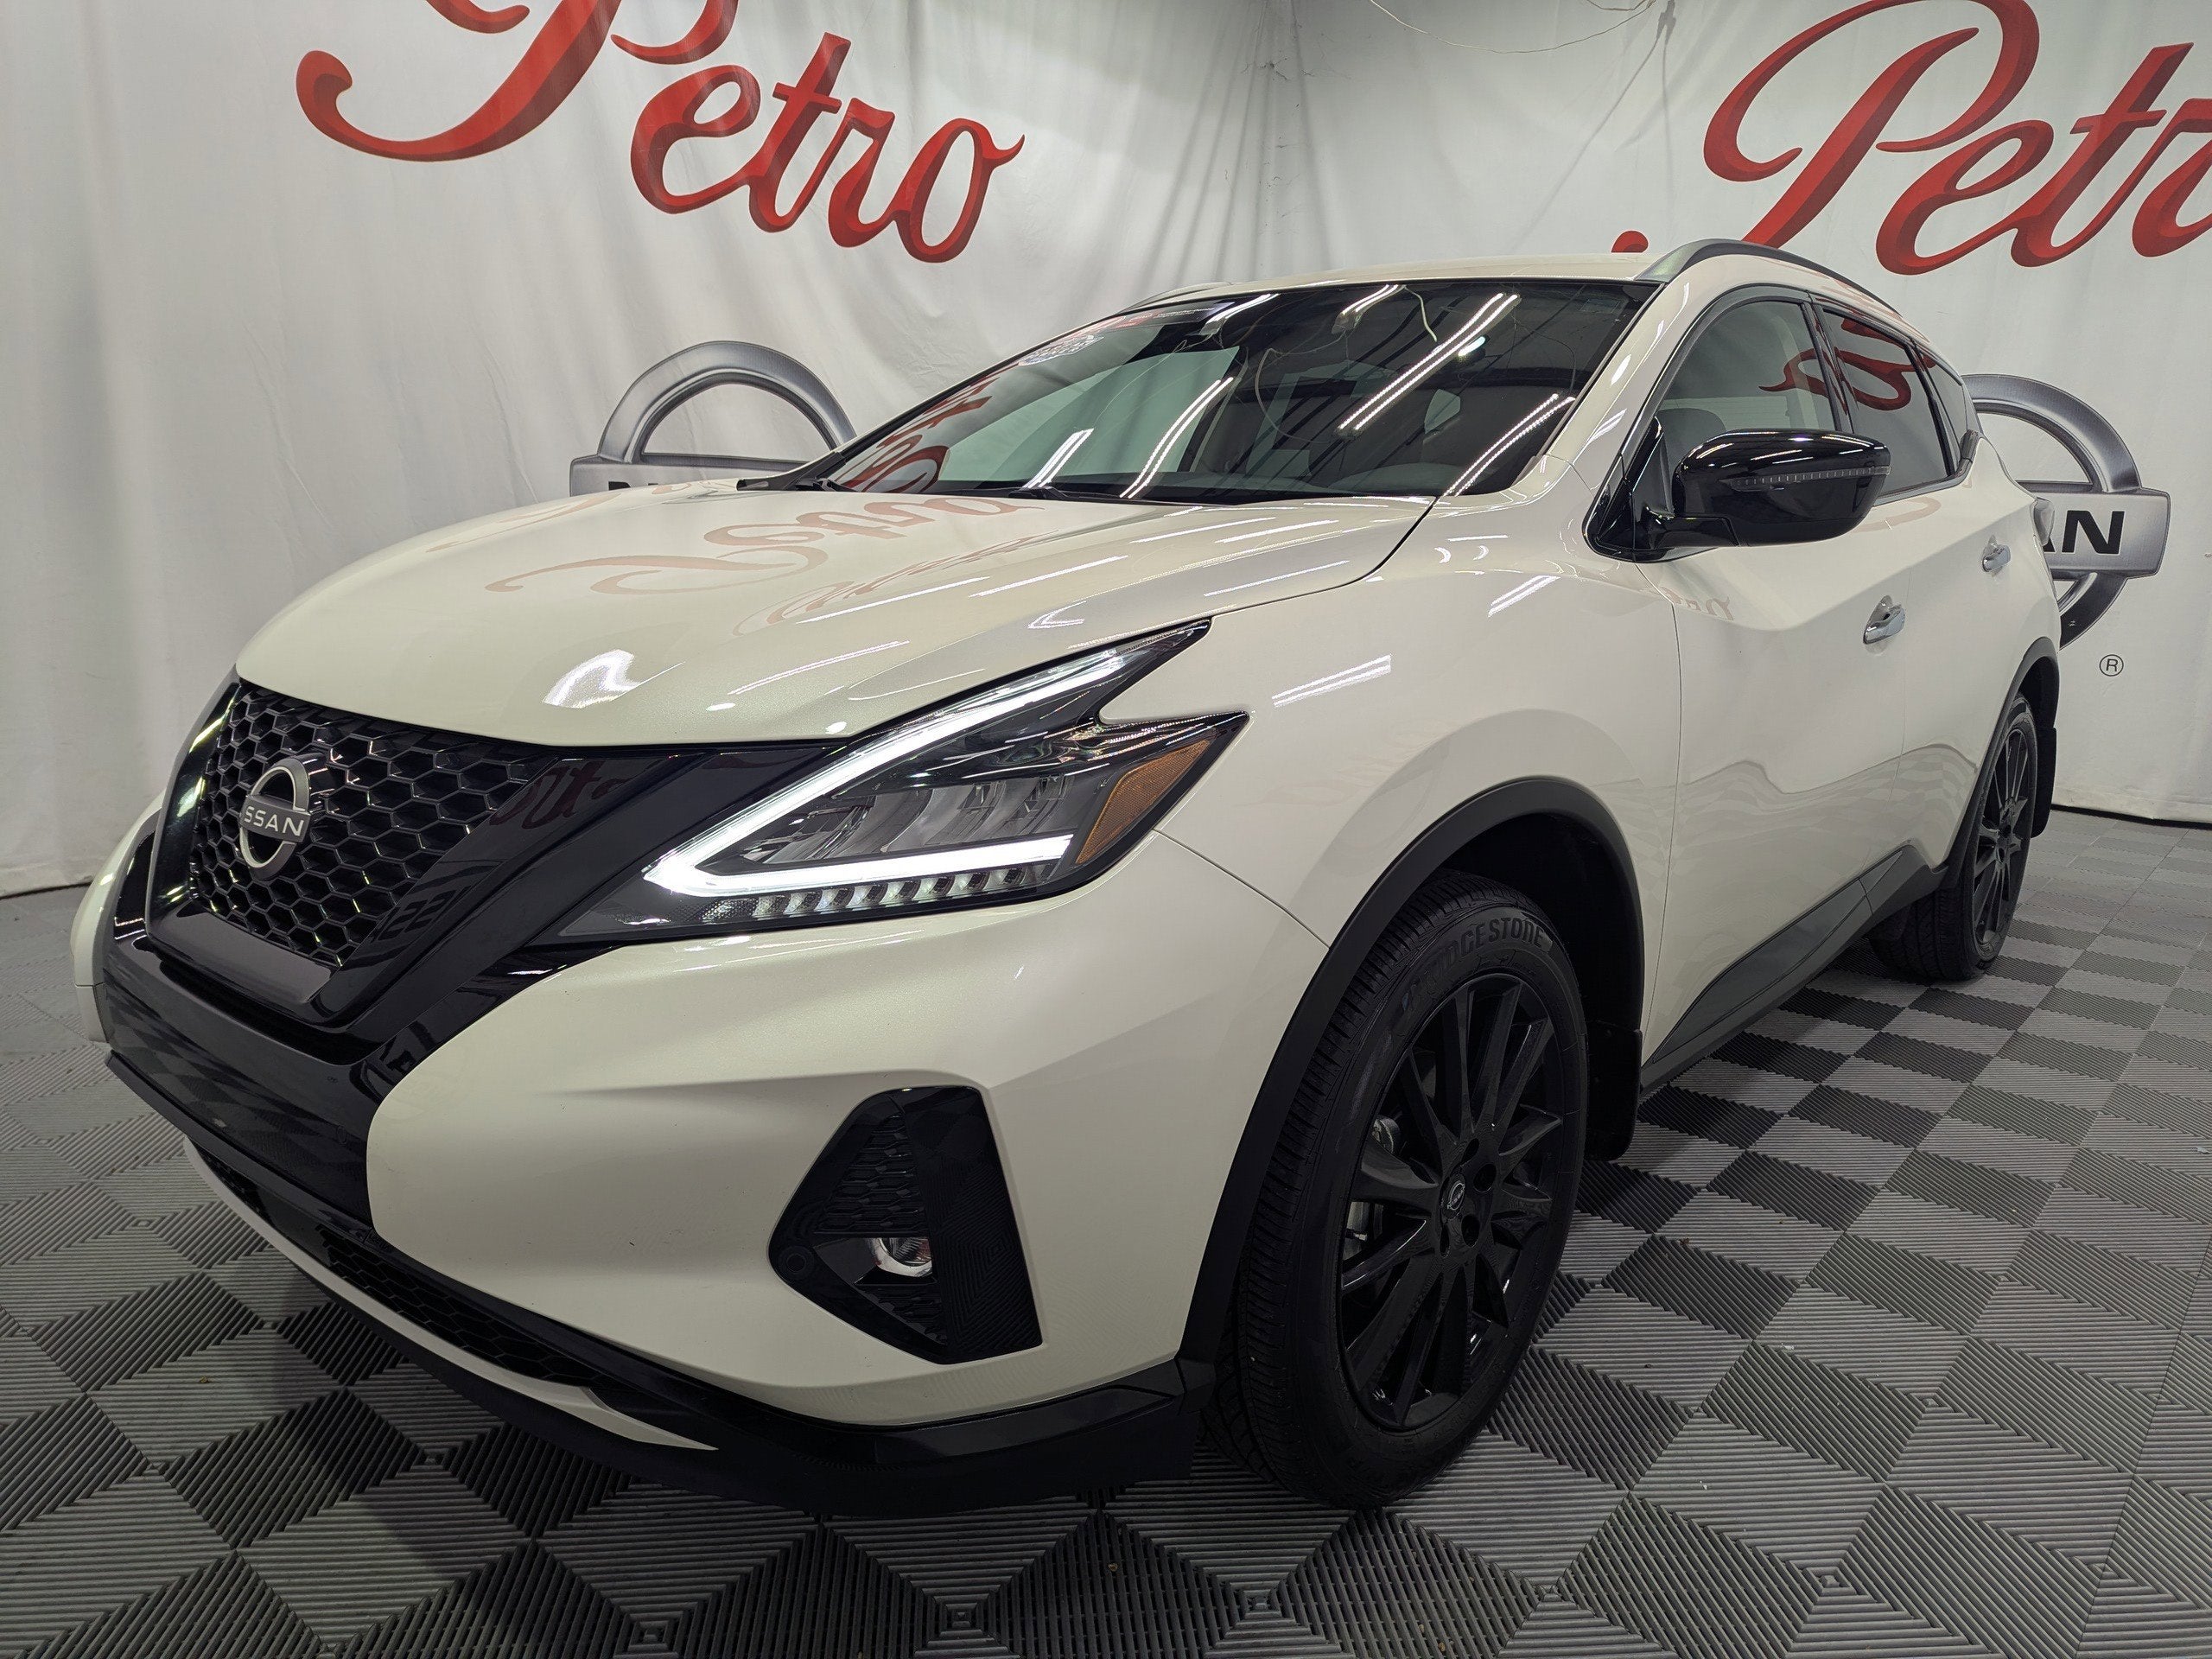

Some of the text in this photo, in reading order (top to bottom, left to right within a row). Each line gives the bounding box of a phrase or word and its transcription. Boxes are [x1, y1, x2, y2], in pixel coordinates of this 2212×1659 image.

[296, 0, 1025, 264] Petro
[1611, 0, 2212, 276] Petr
[244, 804, 304, 836] SSAN
[1408, 917, 1545, 1002] IDGESTONE
